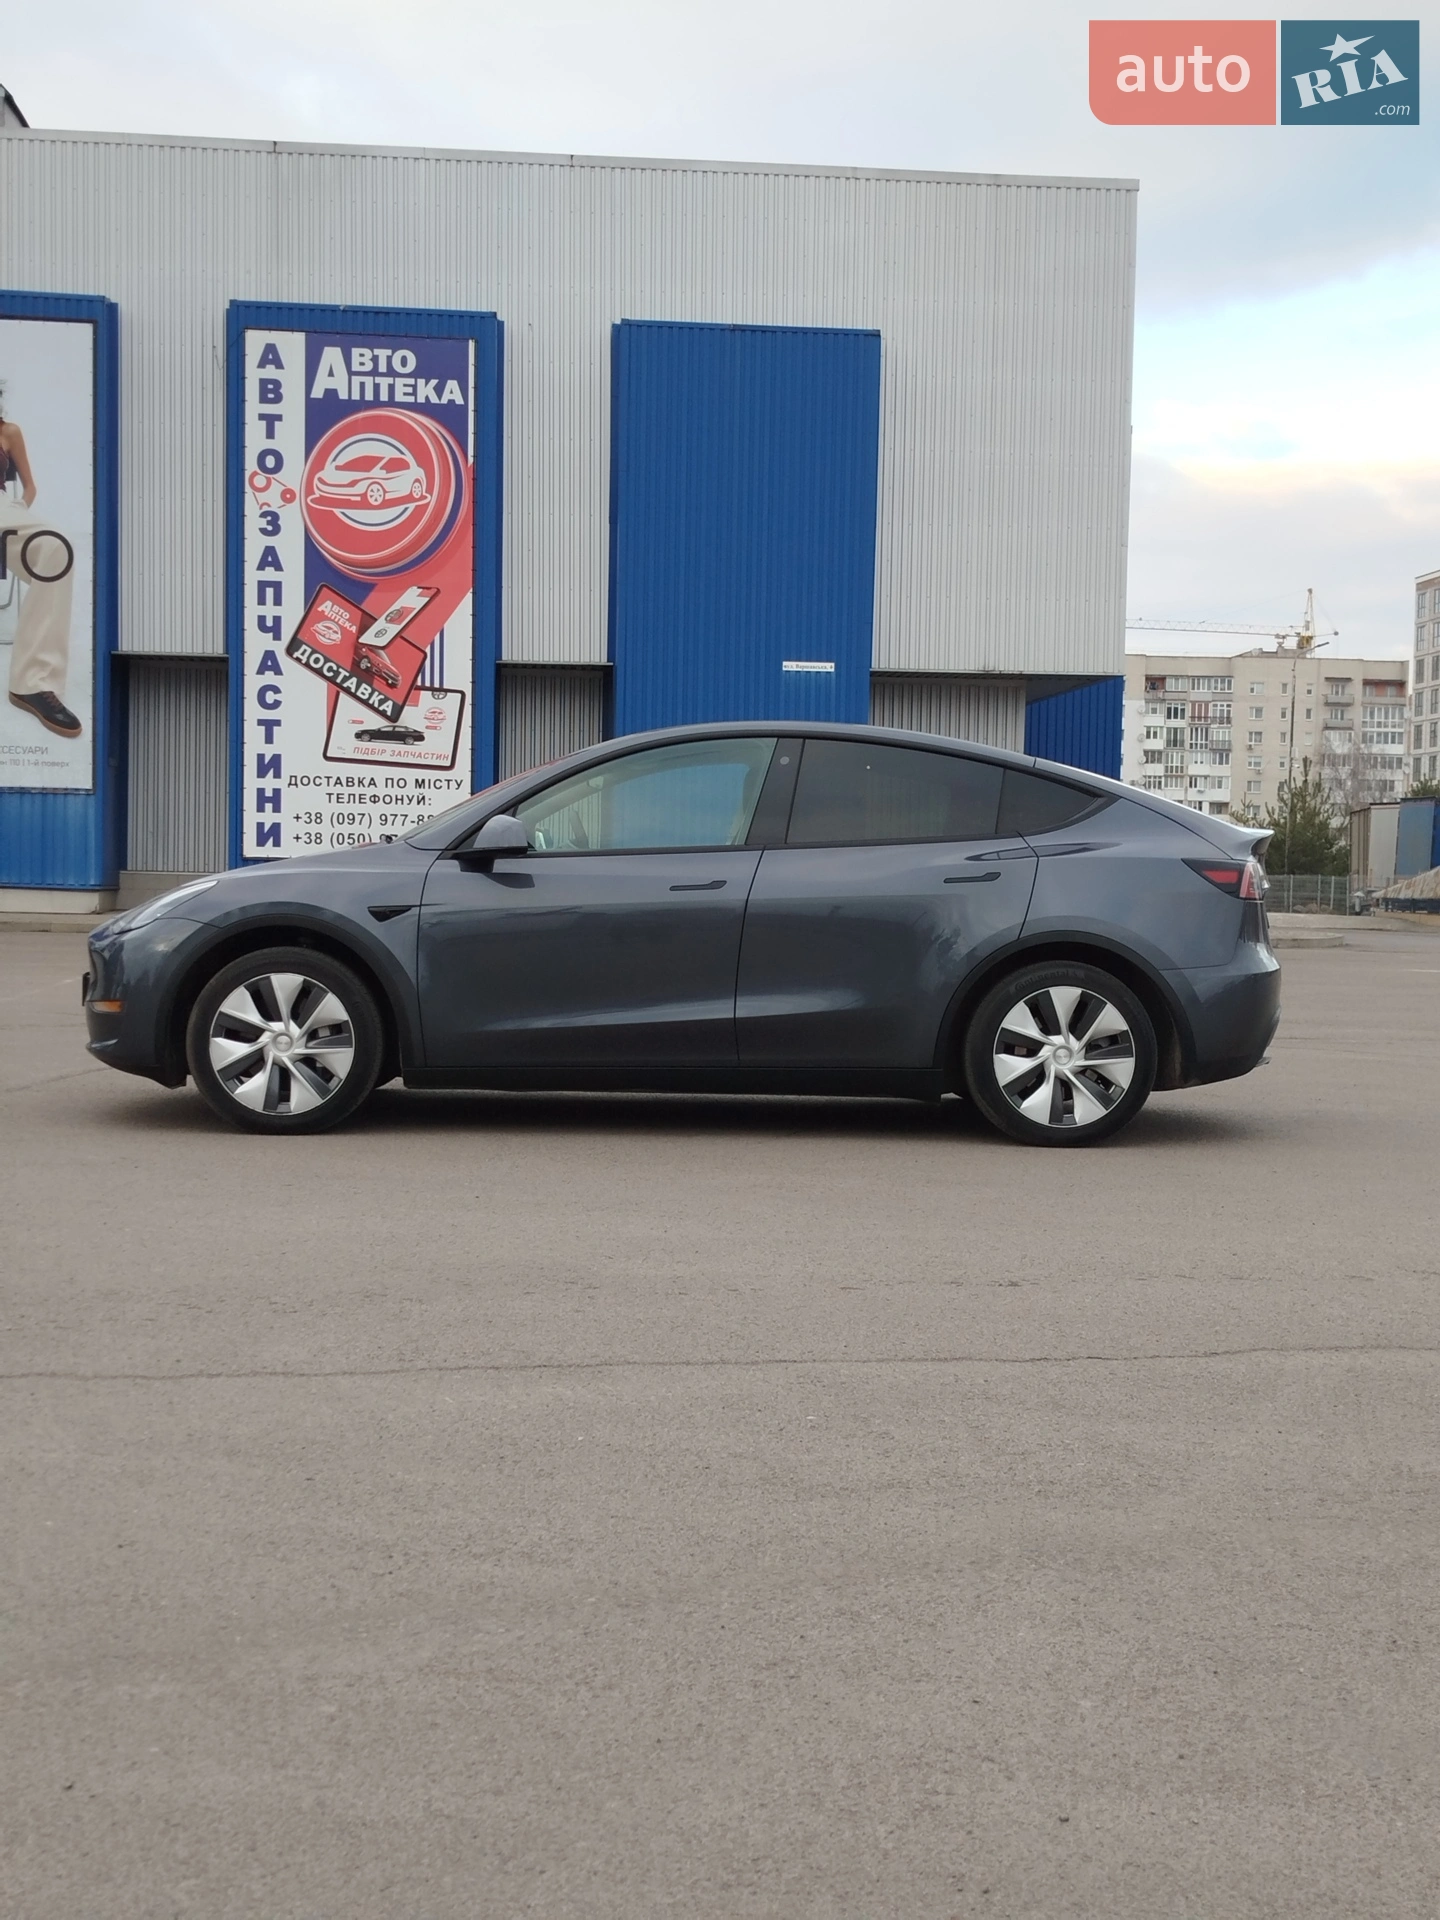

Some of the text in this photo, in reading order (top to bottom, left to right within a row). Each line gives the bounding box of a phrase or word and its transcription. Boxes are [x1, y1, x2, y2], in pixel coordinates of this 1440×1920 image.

[292, 644, 394, 716] ДОСТАВКА
[0, 745, 49, 755] СЕСУАРИ
[353, 746, 387, 757] ПІДБІР
[389, 748, 450, 762] ЗАПЧАСТИН
[287, 774, 464, 791] ДОСТАВКА ПО МІСТУ
[326, 792, 432, 806] ТЕЛЕФОНУЙ:
[292, 811, 324, 826] +38
[330, 811, 373, 830] (097)
[292, 831, 324, 846] +38
